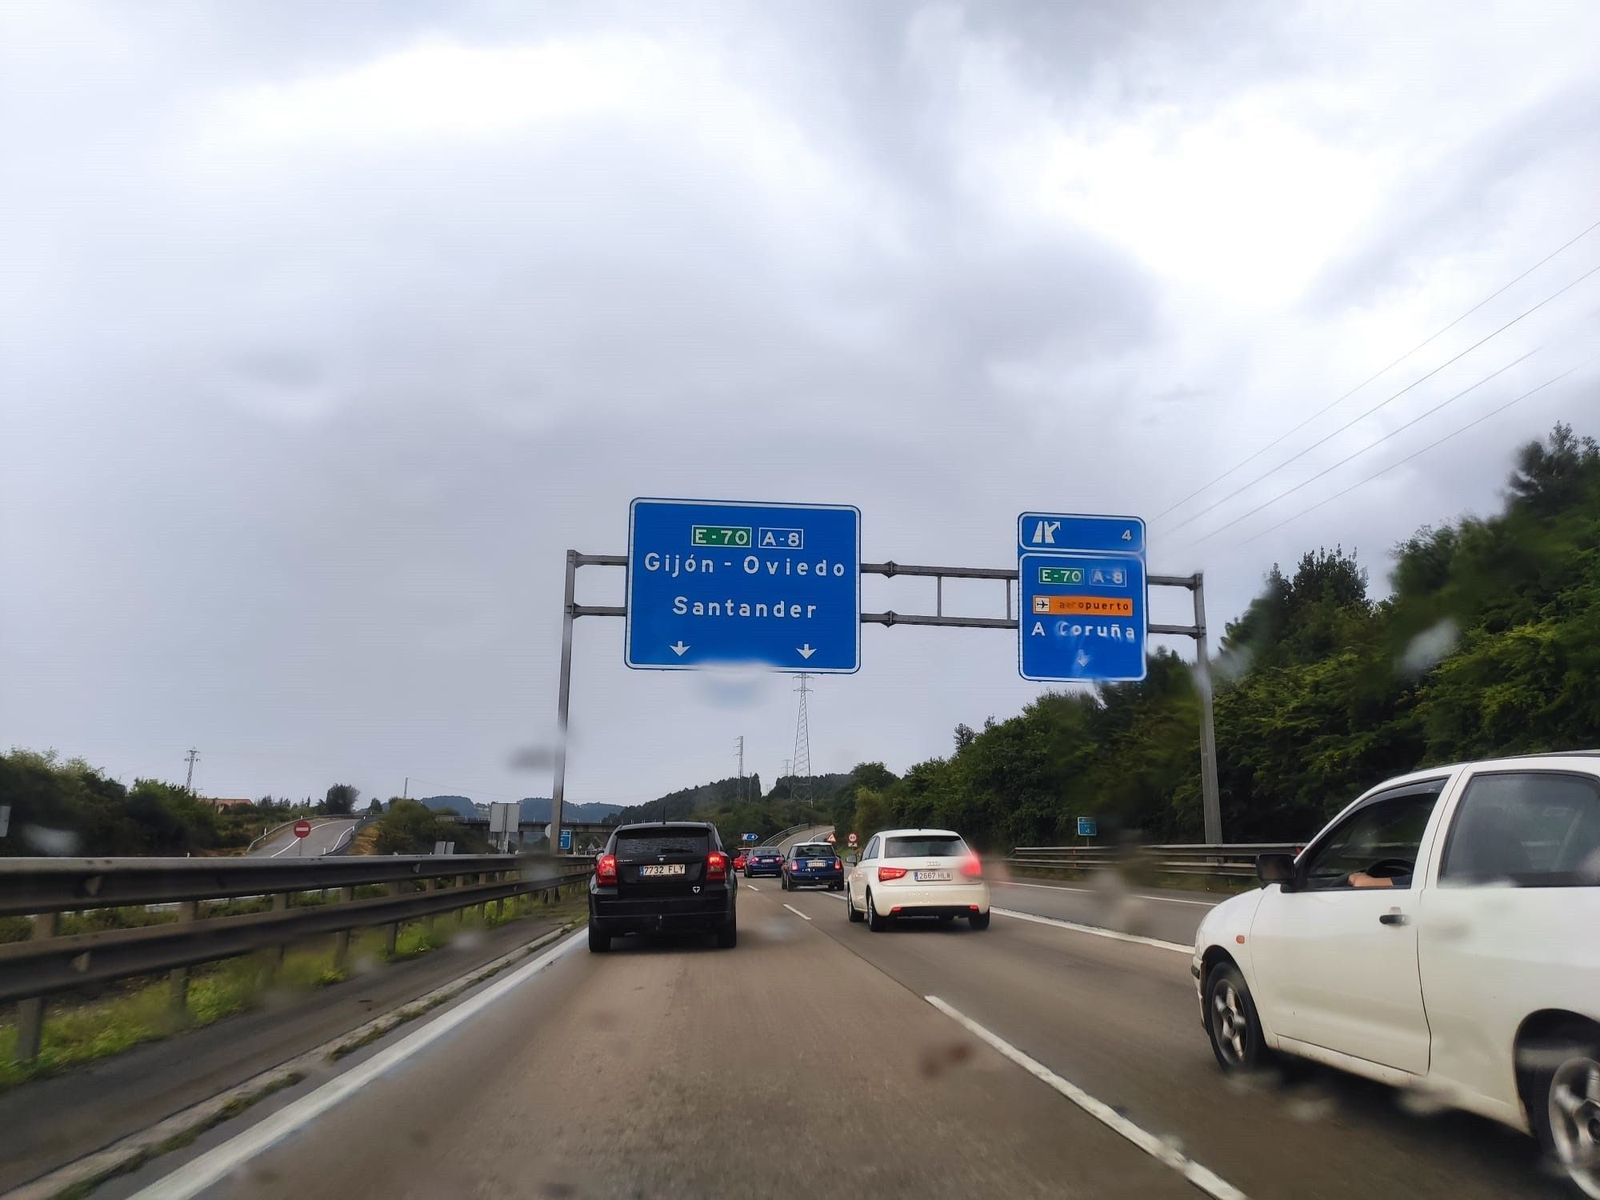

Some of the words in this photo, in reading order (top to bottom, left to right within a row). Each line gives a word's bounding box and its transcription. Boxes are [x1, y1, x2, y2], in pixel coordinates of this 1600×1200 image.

[695, 529, 748, 545] E-70
[762, 531, 800, 547] A-8
[1121, 529, 1132, 541] 4
[644, 552, 714, 578] Gijón
[743, 555, 845, 577] Oviedo
[1042, 570, 1082, 582] E-70
[1092, 570, 1123, 584] A-8
[672, 596, 817, 619] Santander
[1032, 622, 1045, 636] A
[1058, 621, 1135, 641] Coruña
[644, 865, 664, 874] 7732
[668, 864, 684, 873] FLY
